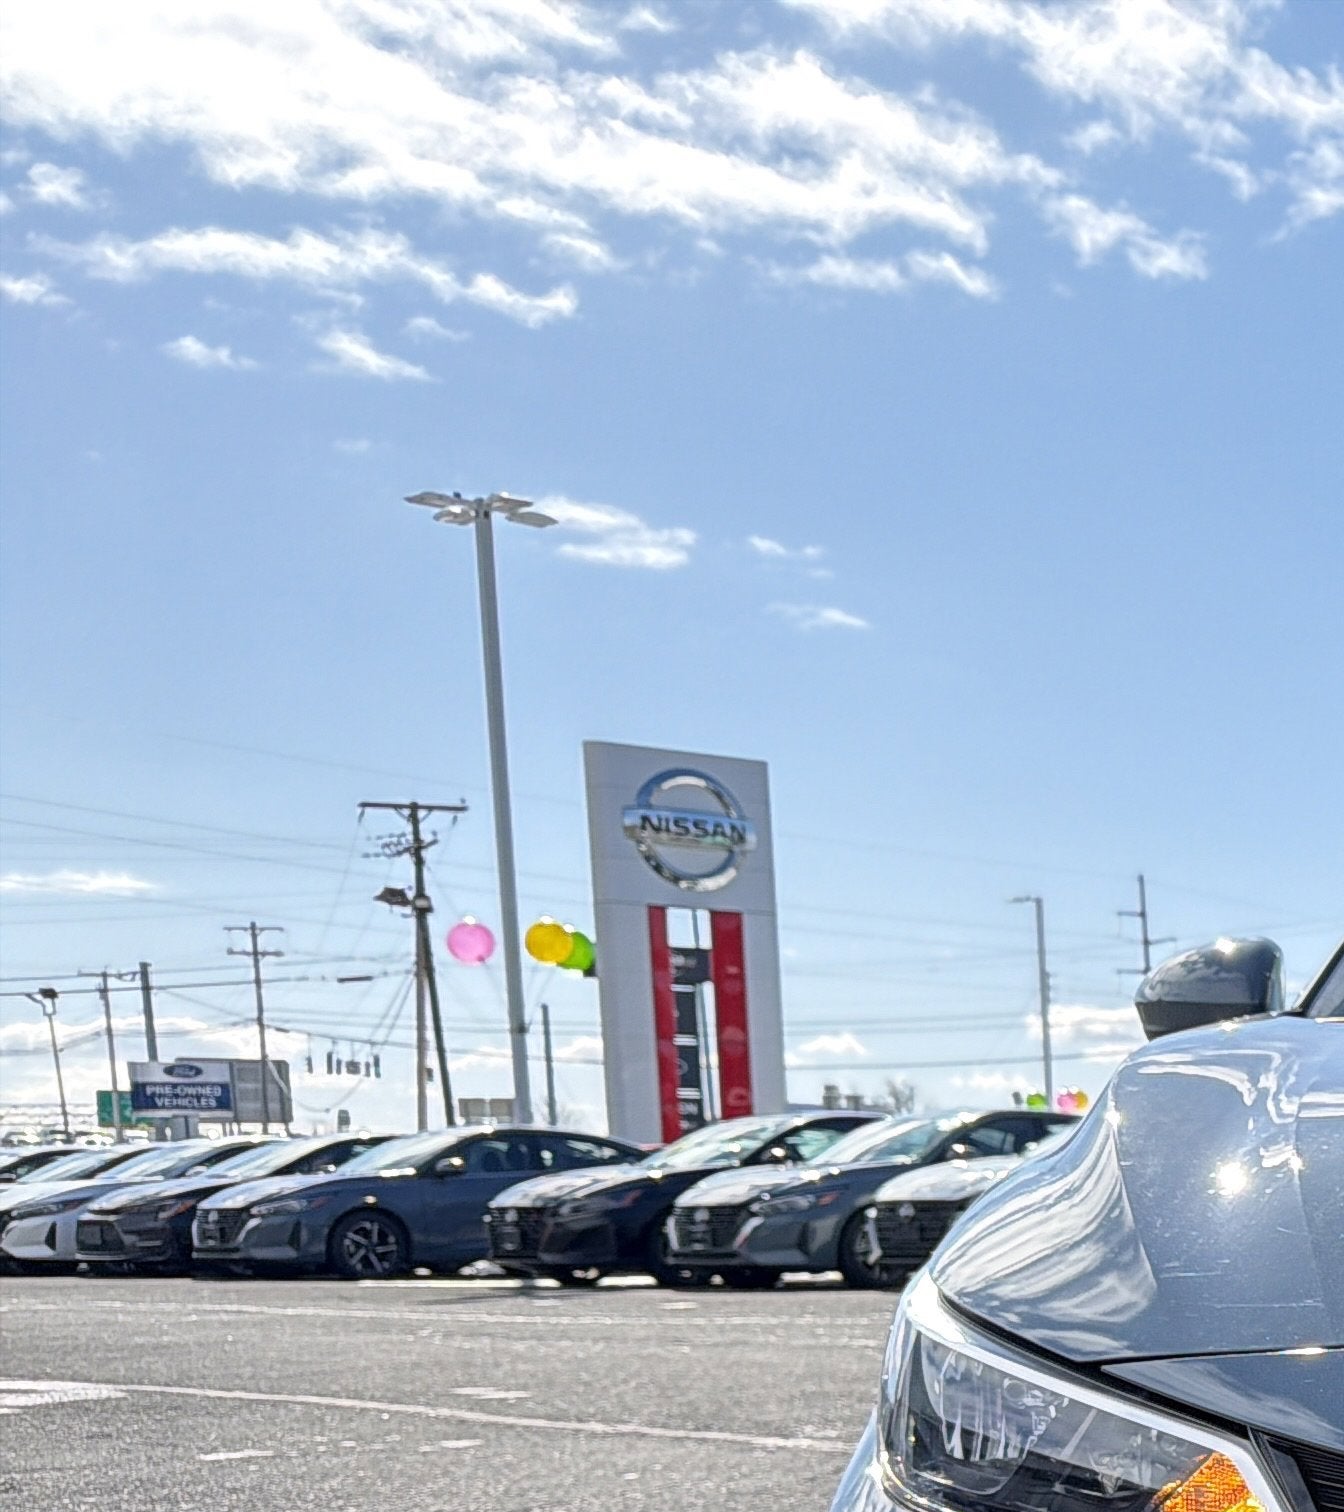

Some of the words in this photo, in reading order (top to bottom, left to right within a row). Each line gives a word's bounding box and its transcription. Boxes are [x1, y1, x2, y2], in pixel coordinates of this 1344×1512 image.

[640, 814, 747, 844] NISSAN
[145, 1084, 222, 1097] PRE-OWNED
[154, 1096, 217, 1108] VEHICLES
